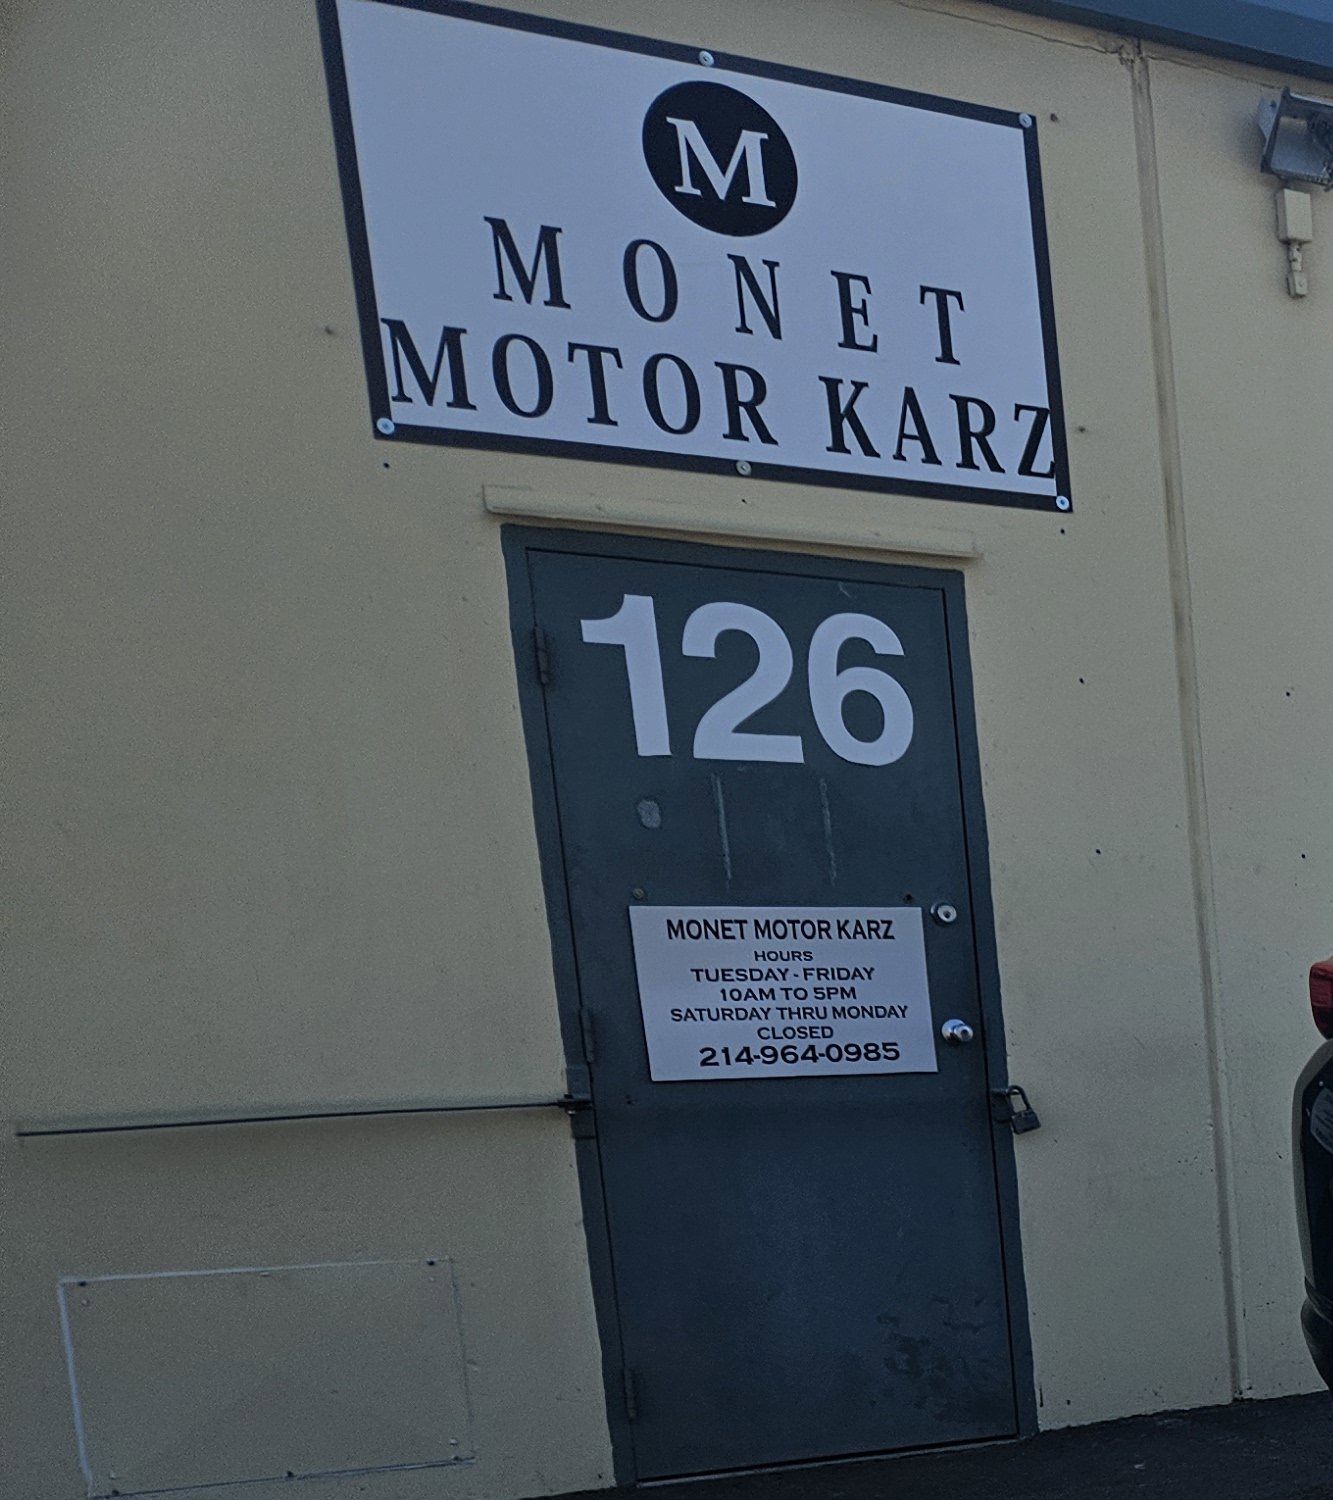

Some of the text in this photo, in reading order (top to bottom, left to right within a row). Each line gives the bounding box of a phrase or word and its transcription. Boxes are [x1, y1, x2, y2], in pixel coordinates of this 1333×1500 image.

[665, 116, 777, 208] M
[484, 216, 964, 366] MONET
[381, 317, 1056, 479] MOTOR KARZ
[580, 594, 914, 766] 126
[666, 919, 895, 940] MONET MOTOR KARZ
[754, 950, 813, 962] HOURS
[690, 968, 790, 982] TUESDAY
[803, 967, 875, 981] FRIDAY
[720, 987, 857, 1002] 10AM TO 5PM
[670, 1005, 908, 1022] SATURDAY THRU MONDAY
[757, 1026, 834, 1040] CLOSED
[699, 1042, 900, 1067] 214-964-0985
